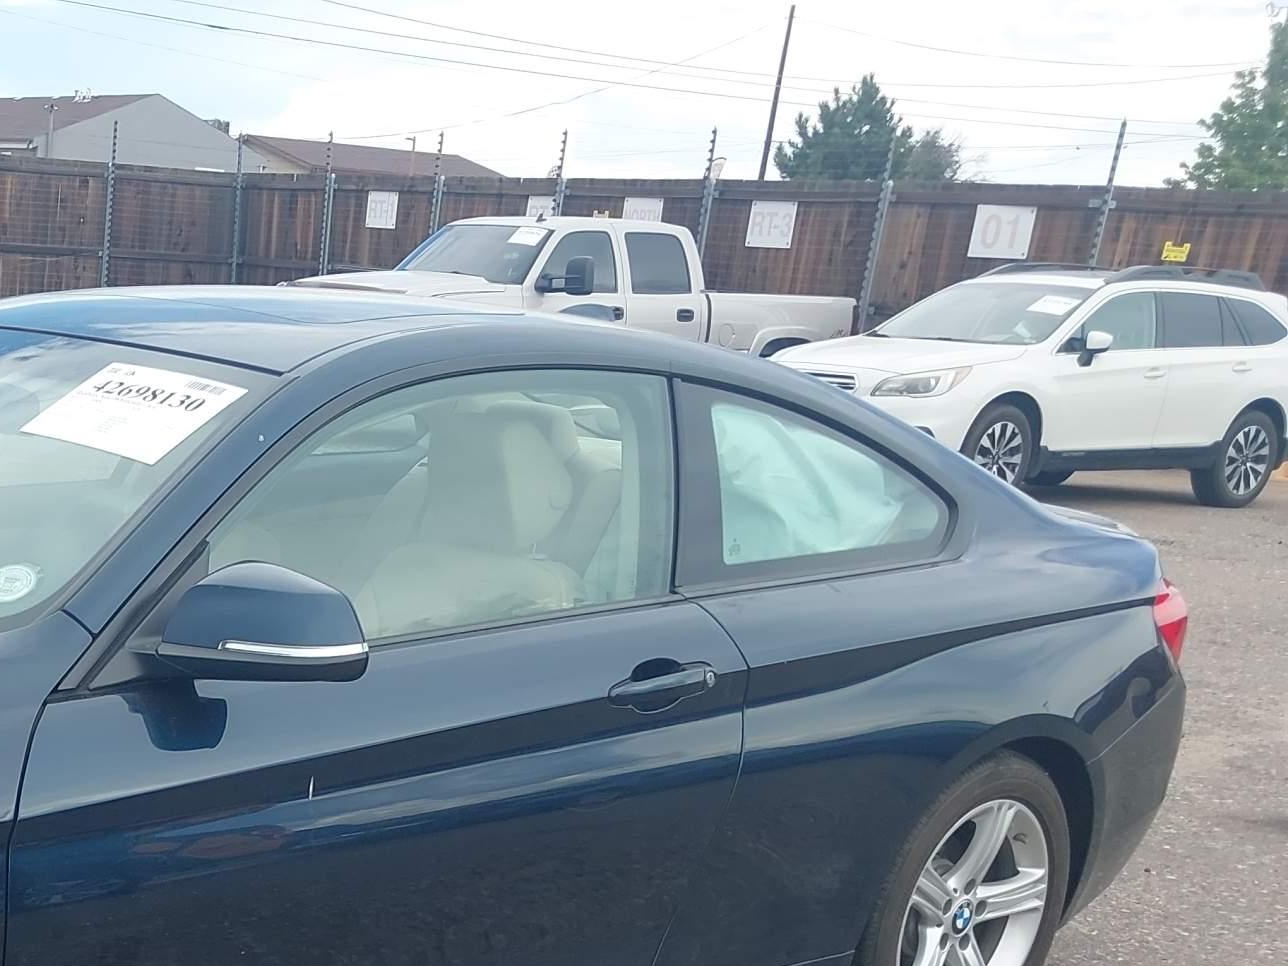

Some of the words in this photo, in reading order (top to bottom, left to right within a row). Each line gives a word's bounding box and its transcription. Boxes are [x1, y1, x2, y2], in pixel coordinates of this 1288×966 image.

[750, 211, 792, 238] RT-3
[980, 214, 1021, 249] 01
[93, 379, 206, 412] 42698130
